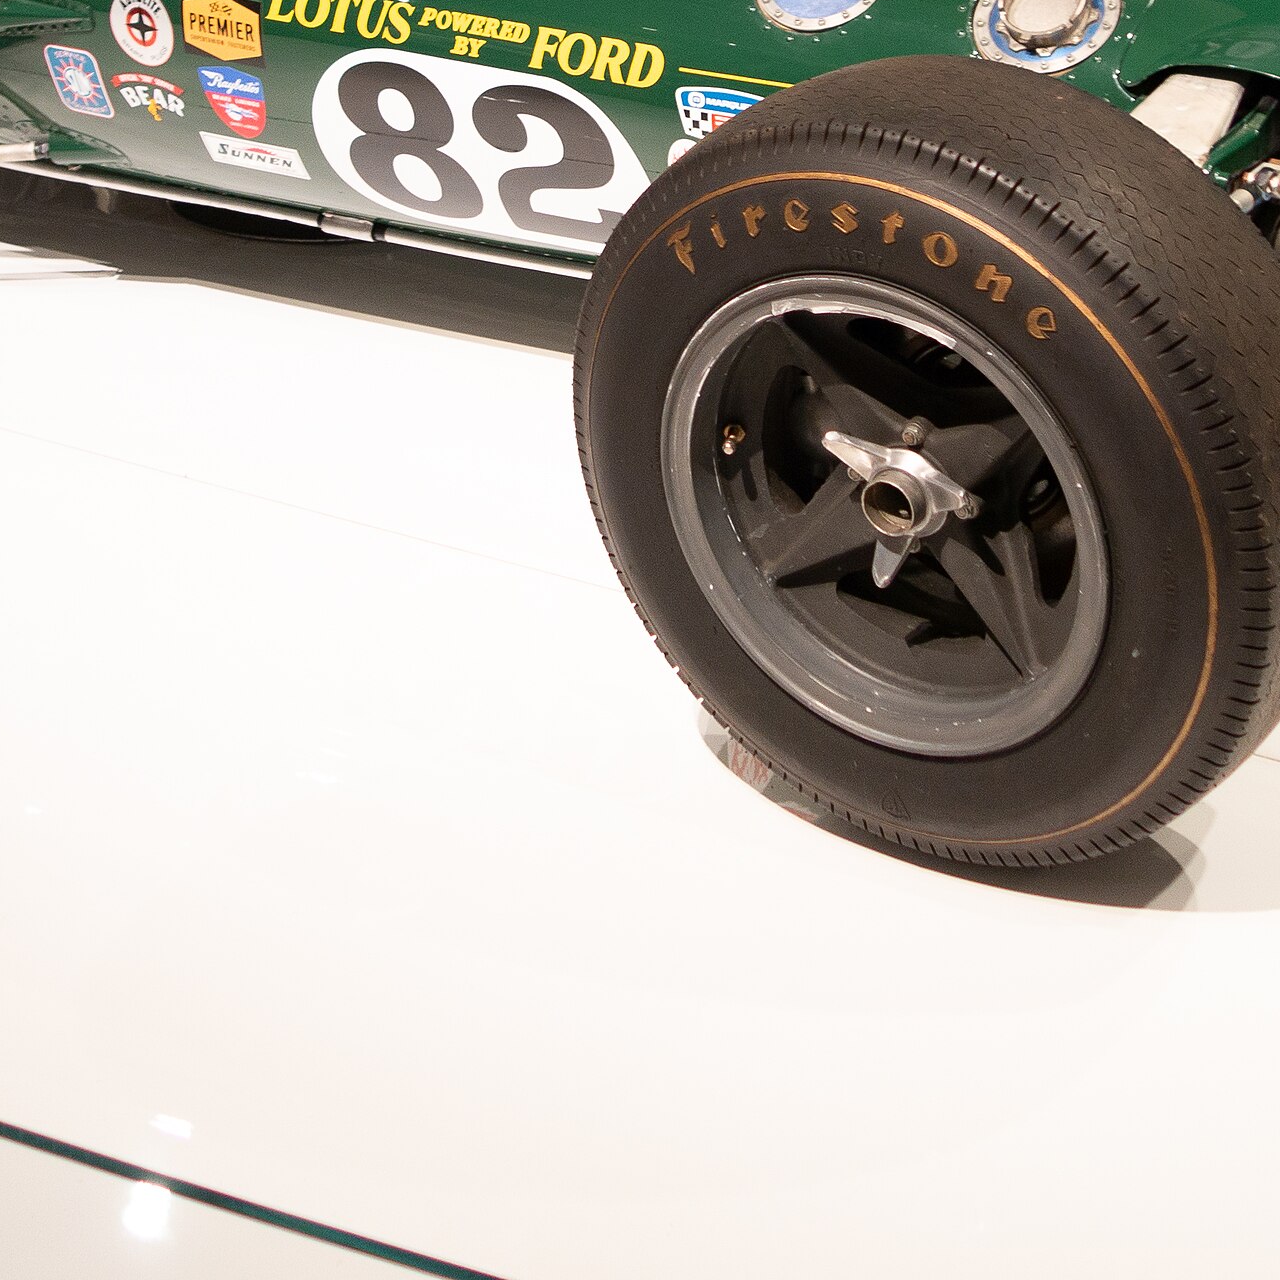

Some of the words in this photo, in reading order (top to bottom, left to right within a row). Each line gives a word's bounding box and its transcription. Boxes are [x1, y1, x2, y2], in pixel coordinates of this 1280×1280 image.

[189, 11, 255, 43] PREMIER
[417, 7, 531, 45] POWERED
[528, 26, 666, 89] FORD
[448, 34, 488, 60] BY
[202, 69, 261, 95] Raybestos
[120, 84, 186, 118] BEAR
[217, 142, 294, 169] SUNNEN
[336, 61, 623, 246] 82
[666, 197, 1059, 341] Firestone
